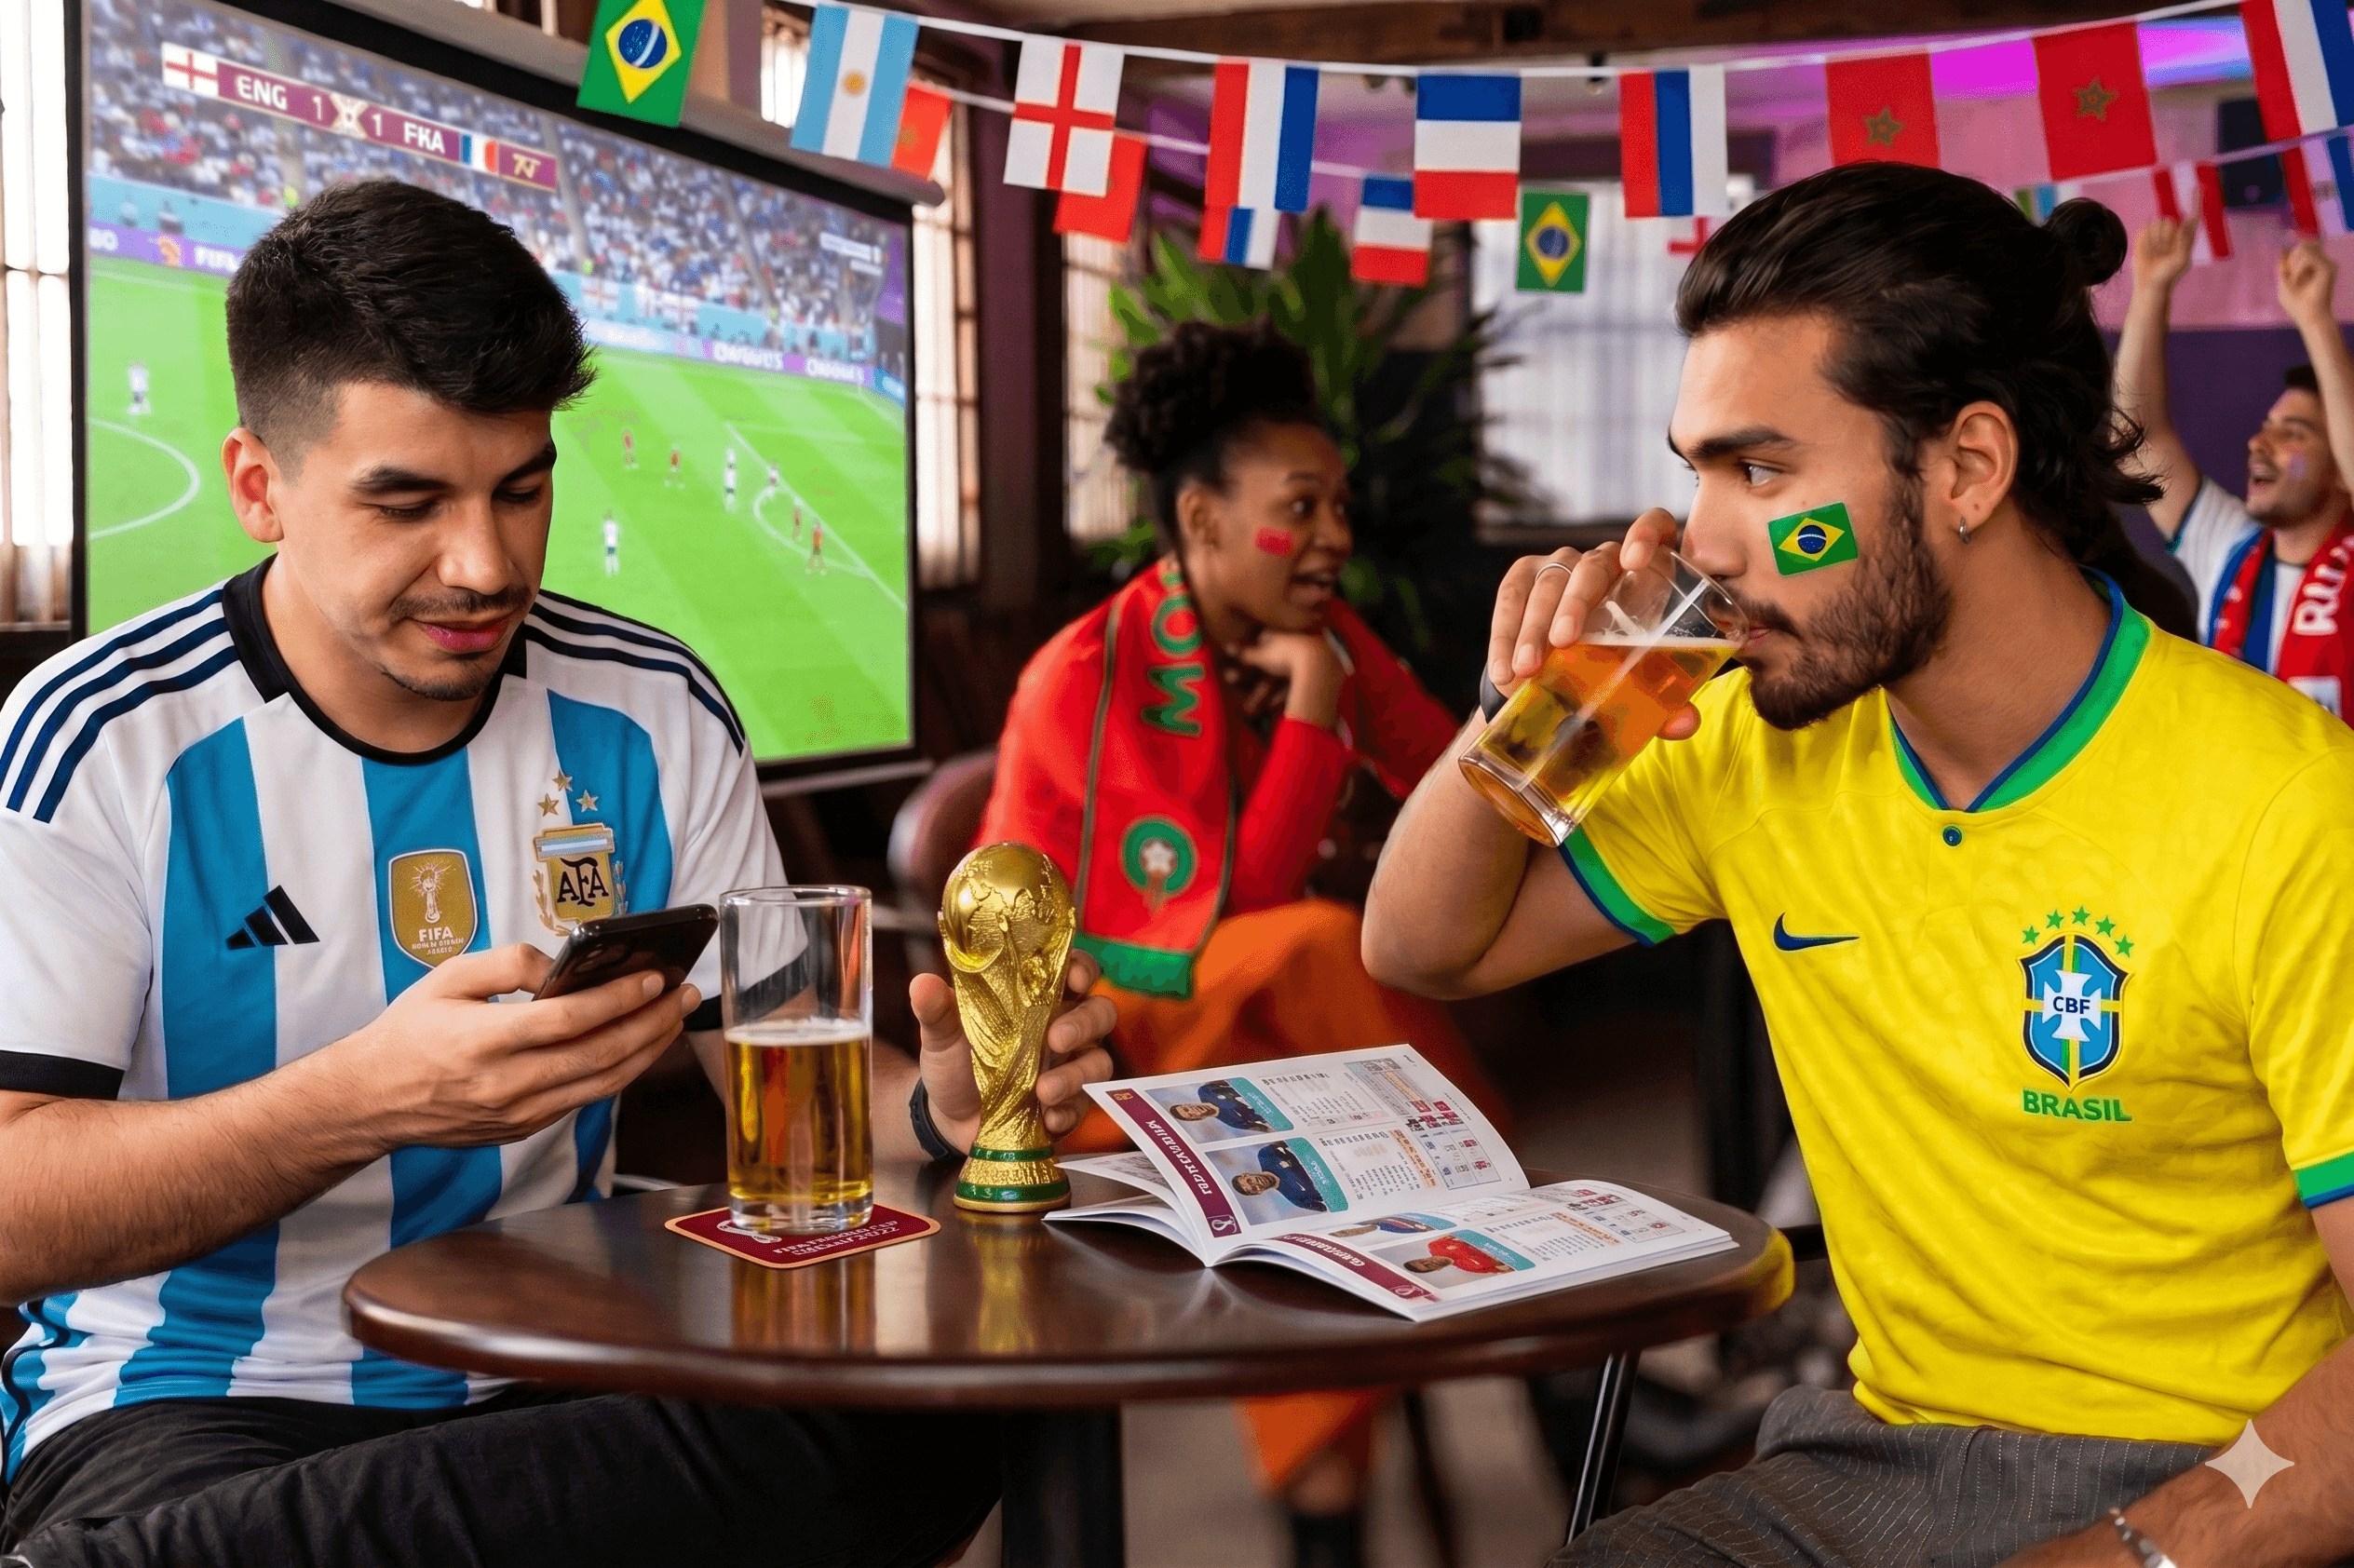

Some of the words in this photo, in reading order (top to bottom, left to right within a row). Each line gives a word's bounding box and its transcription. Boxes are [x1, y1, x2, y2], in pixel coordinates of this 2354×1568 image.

[237, 74, 288, 111] ENG
[312, 95, 323, 121] 1
[372, 113, 383, 137] 1
[2292, 534, 2354, 637] RU
[556, 857, 610, 908] AFA
[418, 926, 454, 942] FIFA
[2052, 995, 2090, 1015] CBF
[2023, 1089, 2132, 1122] BRASIL
